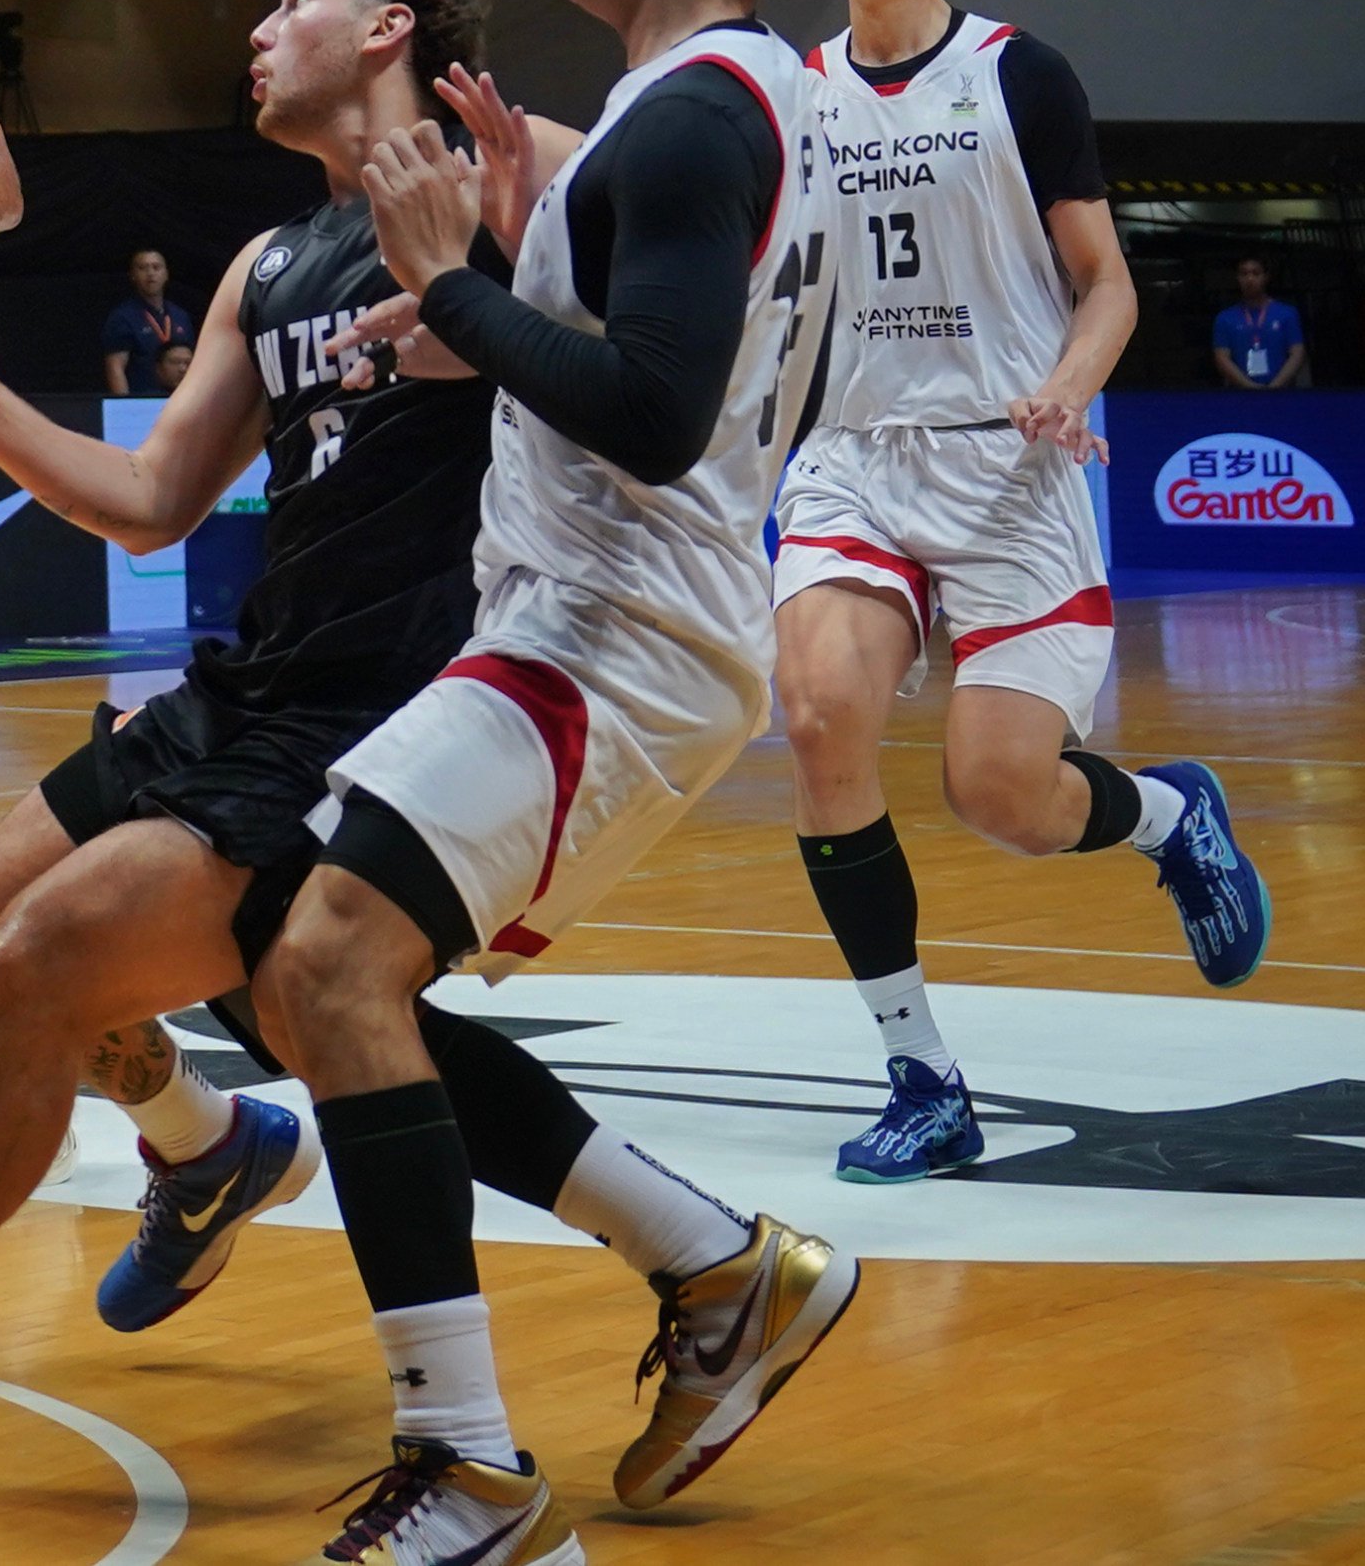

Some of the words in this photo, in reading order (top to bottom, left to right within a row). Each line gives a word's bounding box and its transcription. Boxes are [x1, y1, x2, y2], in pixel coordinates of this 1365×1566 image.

[893, 131, 979, 158] KONG
[837, 162, 937, 196] CHINA
[868, 212, 920, 281] 13
[868, 305, 970, 323] ANYTIME
[869, 323, 974, 340] FITNESS
[1187, 449, 1294, 479] 百岁山
